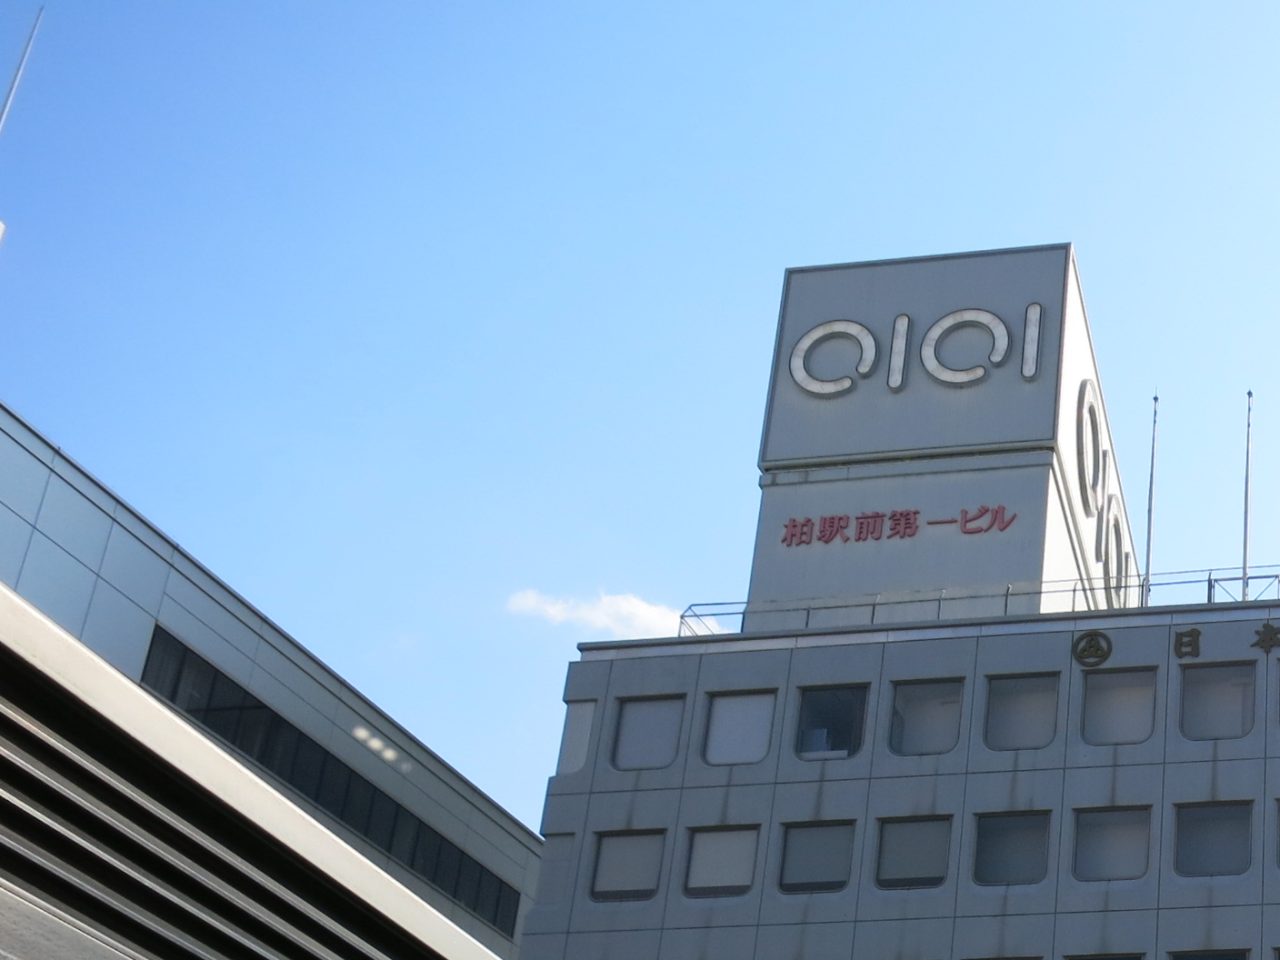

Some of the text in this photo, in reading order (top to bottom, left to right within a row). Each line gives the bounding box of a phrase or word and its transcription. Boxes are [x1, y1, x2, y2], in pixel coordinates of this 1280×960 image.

[781, 504, 1017, 547] 柏駅前第一ビル
